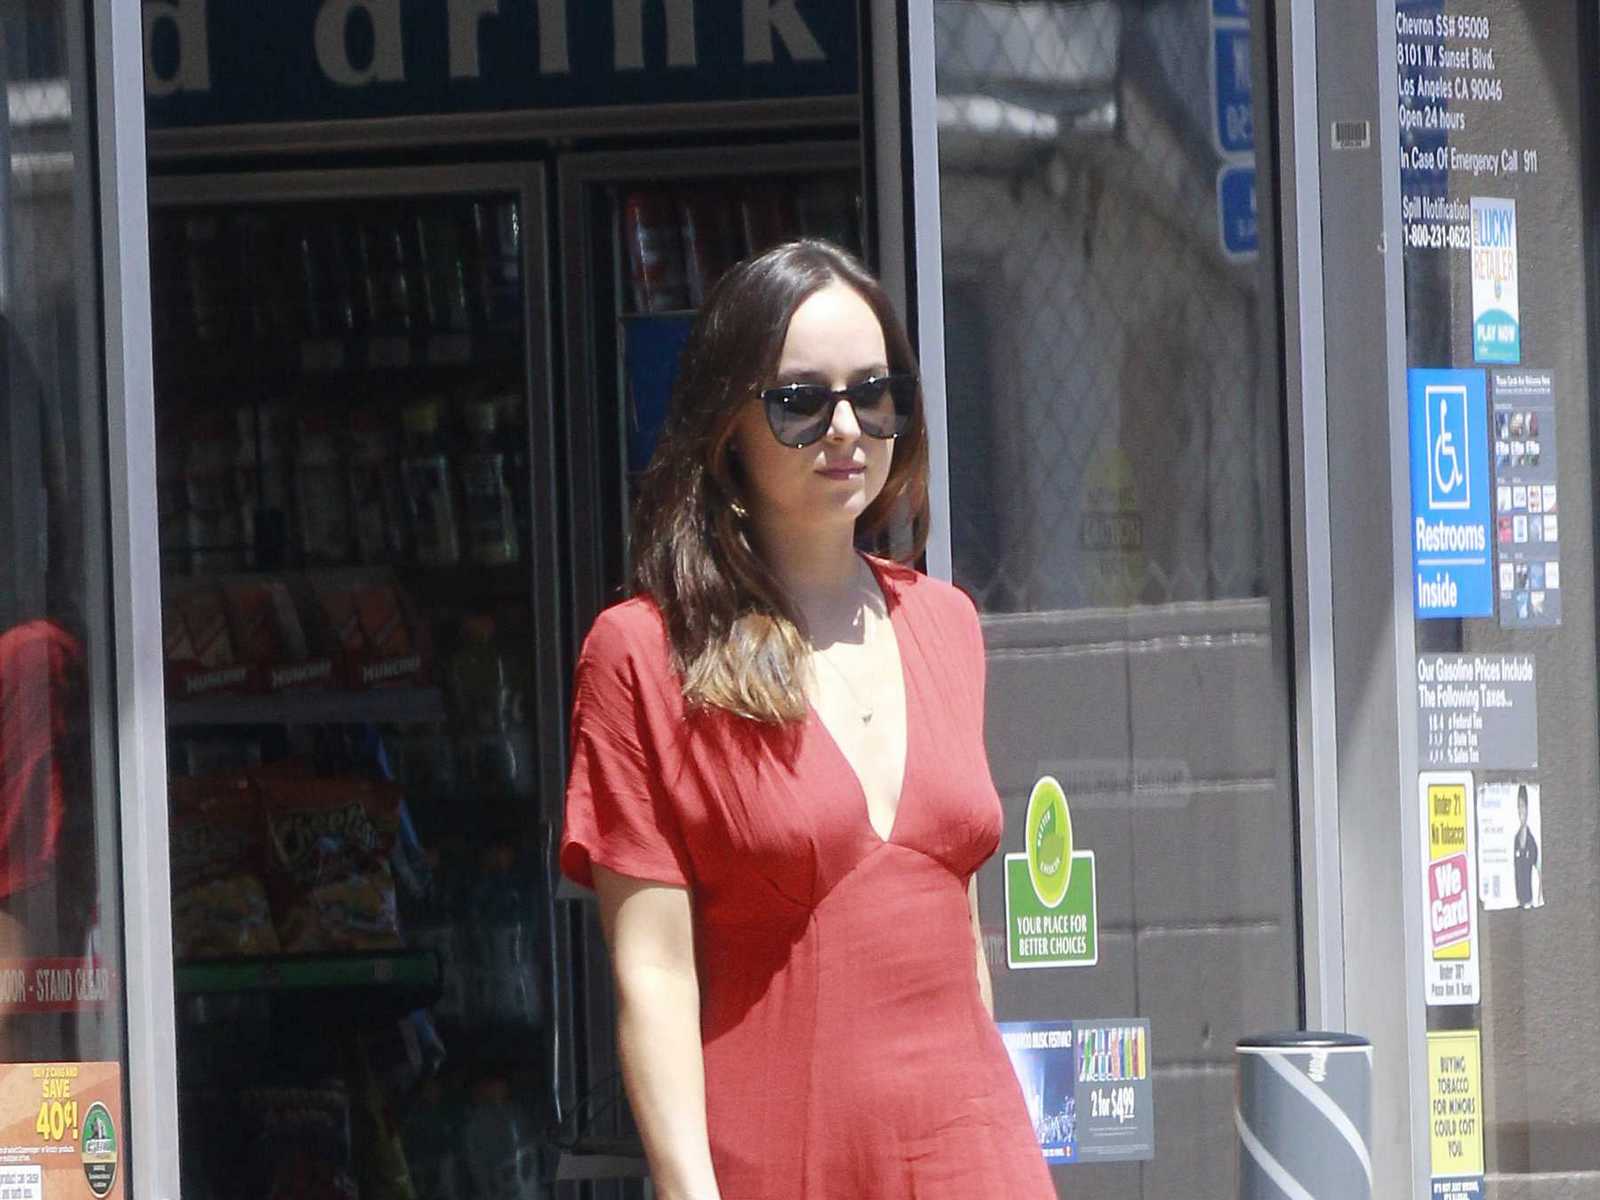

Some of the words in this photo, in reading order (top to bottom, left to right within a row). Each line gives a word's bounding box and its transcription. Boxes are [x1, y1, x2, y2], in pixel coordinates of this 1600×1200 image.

[1396, 12, 1434, 35] Chevron
[1436, 15, 1456, 37] SS#
[1458, 16, 1490, 39] 95008
[1397, 43, 1422, 65] 8101
[1425, 45, 1437, 67] W.
[1438, 47, 1470, 69] Sunset
[1472, 48, 1495, 70] Blvd.
[1398, 75, 1415, 96] Los
[1418, 75, 1453, 102] Angeles
[1455, 78, 1469, 98] CA
[1471, 78, 1503, 100] 90046
[1399, 106, 1423, 130] Open
[1425, 107, 1438, 128] 24
[1440, 108, 1465, 130] hours
[1401, 148, 1411, 169] In
[1412, 147, 1434, 169] Case
[1437, 147, 1448, 169] Of
[1451, 148, 1499, 176] Emergency
[1501, 150, 1518, 171] Call
[1524, 150, 1538, 173] 911
[1403, 196, 1421, 224] Spill
[1423, 198, 1470, 220] Notification
[1404, 224, 1471, 248] 1-800-231-0623
[1480, 207, 1513, 247] LUCKY
[1416, 517, 1485, 552] Restrooms
[1418, 573, 1457, 608] Inside
[1418, 658, 1434, 682] Our
[1436, 657, 1473, 682] Gasoline
[1475, 657, 1500, 681] Prices
[1502, 656, 1533, 681] Include
[1418, 684, 1435, 708] The
[1437, 683, 1479, 712] Following
[1434, 794, 1451, 816] Under
[1432, 823, 1440, 845] No
[1440, 821, 1464, 845] Tobacco
[1435, 863, 1462, 899] We
[1431, 888, 1468, 933] Card
[1017, 915, 1042, 936] YOUR
[1043, 914, 1069, 935] PLACE
[1070, 914, 1087, 933] FOR
[1019, 937, 1048, 957] BETTER
[1050, 935, 1087, 955] CHOICES
[36, 967, 73, 1002] STAND
[1440, 1056, 1465, 1073] BUYING
[42, 1080, 71, 1098] SAVE
[1438, 1077, 1469, 1094] TOBACCO
[1090, 1090, 1097, 1118] 2
[1098, 1088, 1110, 1117] for
[1433, 1099, 1446, 1116] FOR
[1449, 1097, 1475, 1114] MINORS
[1435, 1120, 1456, 1137] COULD
[1459, 1119, 1475, 1136] COST
